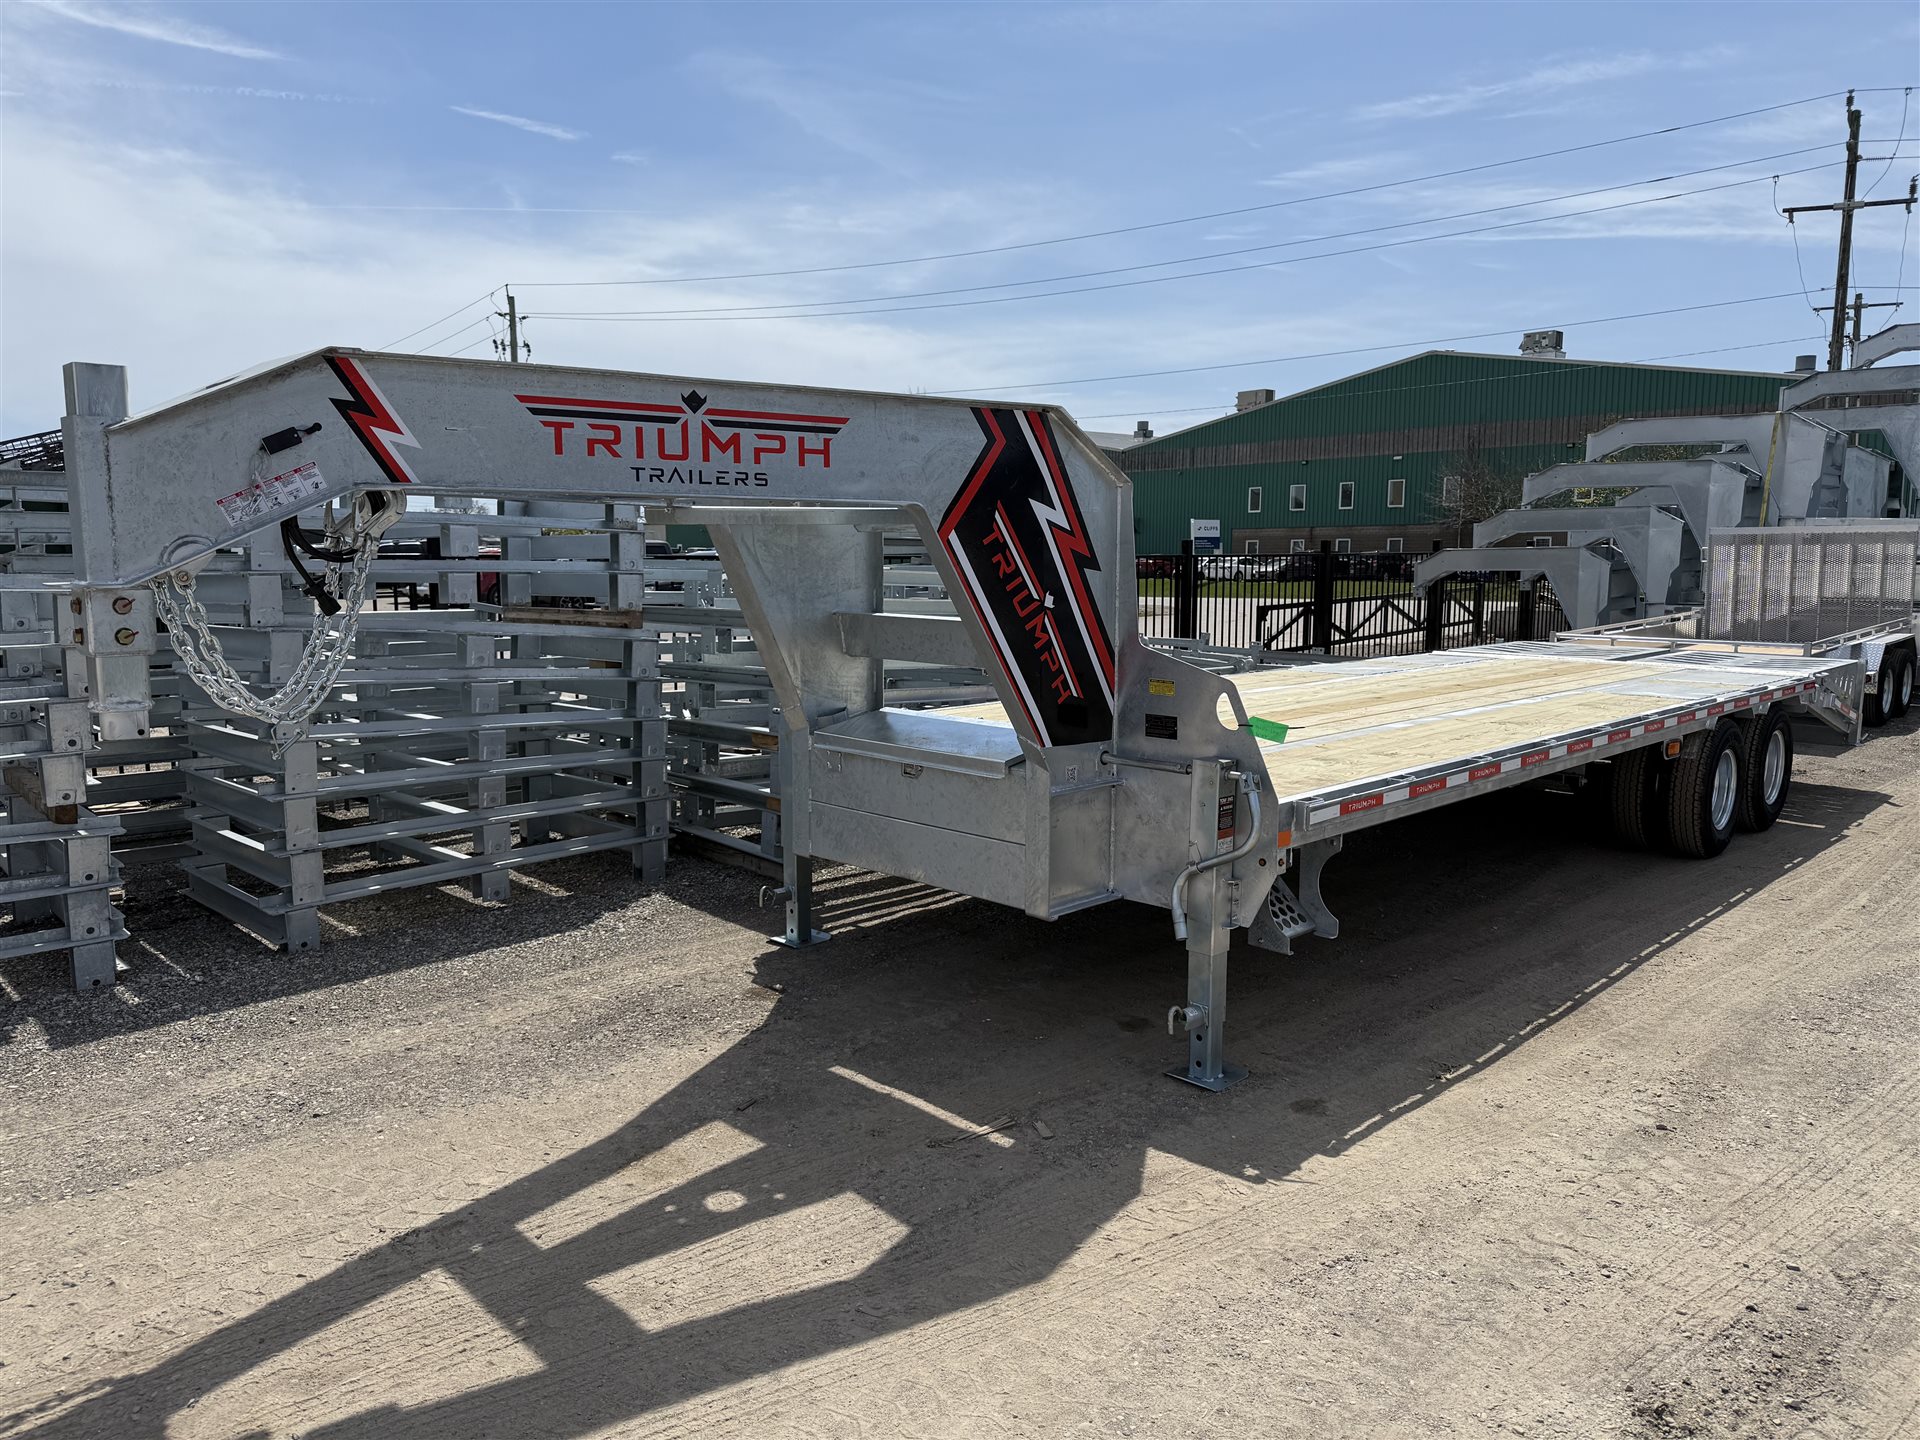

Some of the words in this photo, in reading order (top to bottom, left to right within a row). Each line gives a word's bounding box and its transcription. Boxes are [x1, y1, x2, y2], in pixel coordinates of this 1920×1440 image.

[539, 418, 833, 468] TRIUMPH
[629, 466, 769, 487] TRAILERS
[982, 521, 1071, 705] TRIUMPH
[1416, 782, 1440, 794] TRIUMPH
[1348, 798, 1376, 811] TRIUMPH
